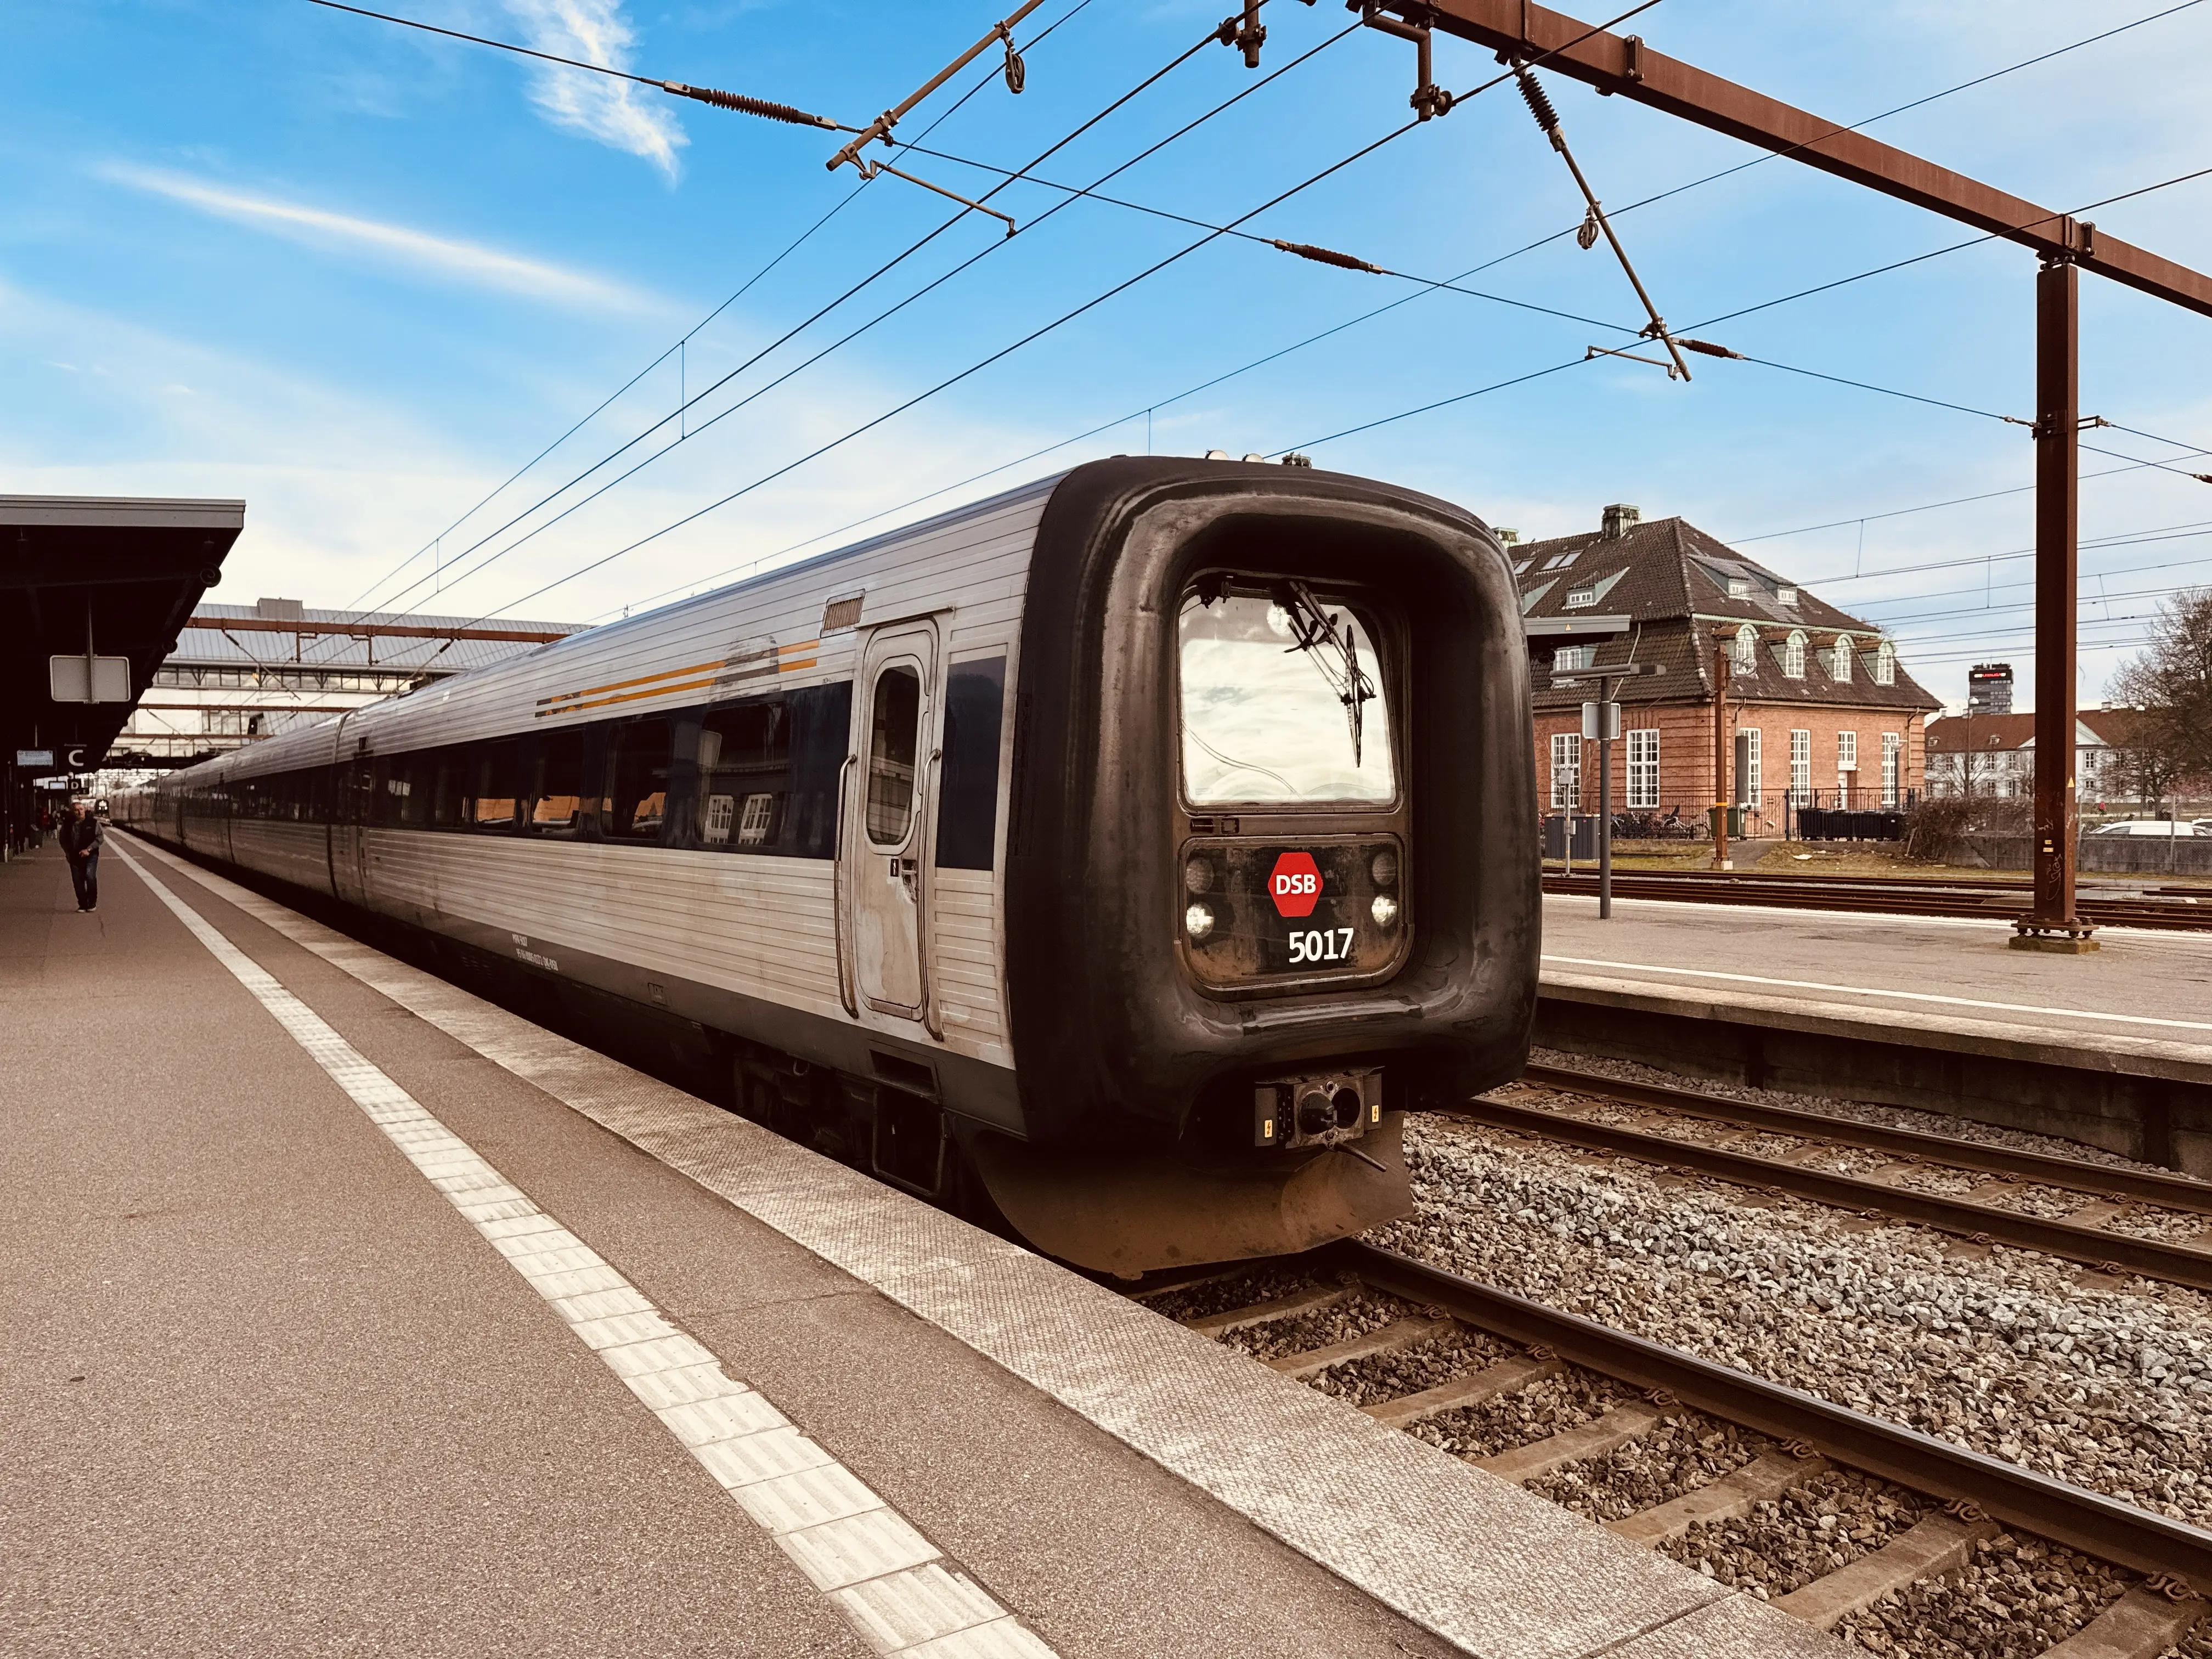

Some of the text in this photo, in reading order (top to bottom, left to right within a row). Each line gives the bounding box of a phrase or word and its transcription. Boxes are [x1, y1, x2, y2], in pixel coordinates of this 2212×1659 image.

[68, 749, 84, 766] C
[71, 781, 79, 789] D
[1276, 874, 1316, 894] DSB
[1289, 928, 1354, 963] 5017
